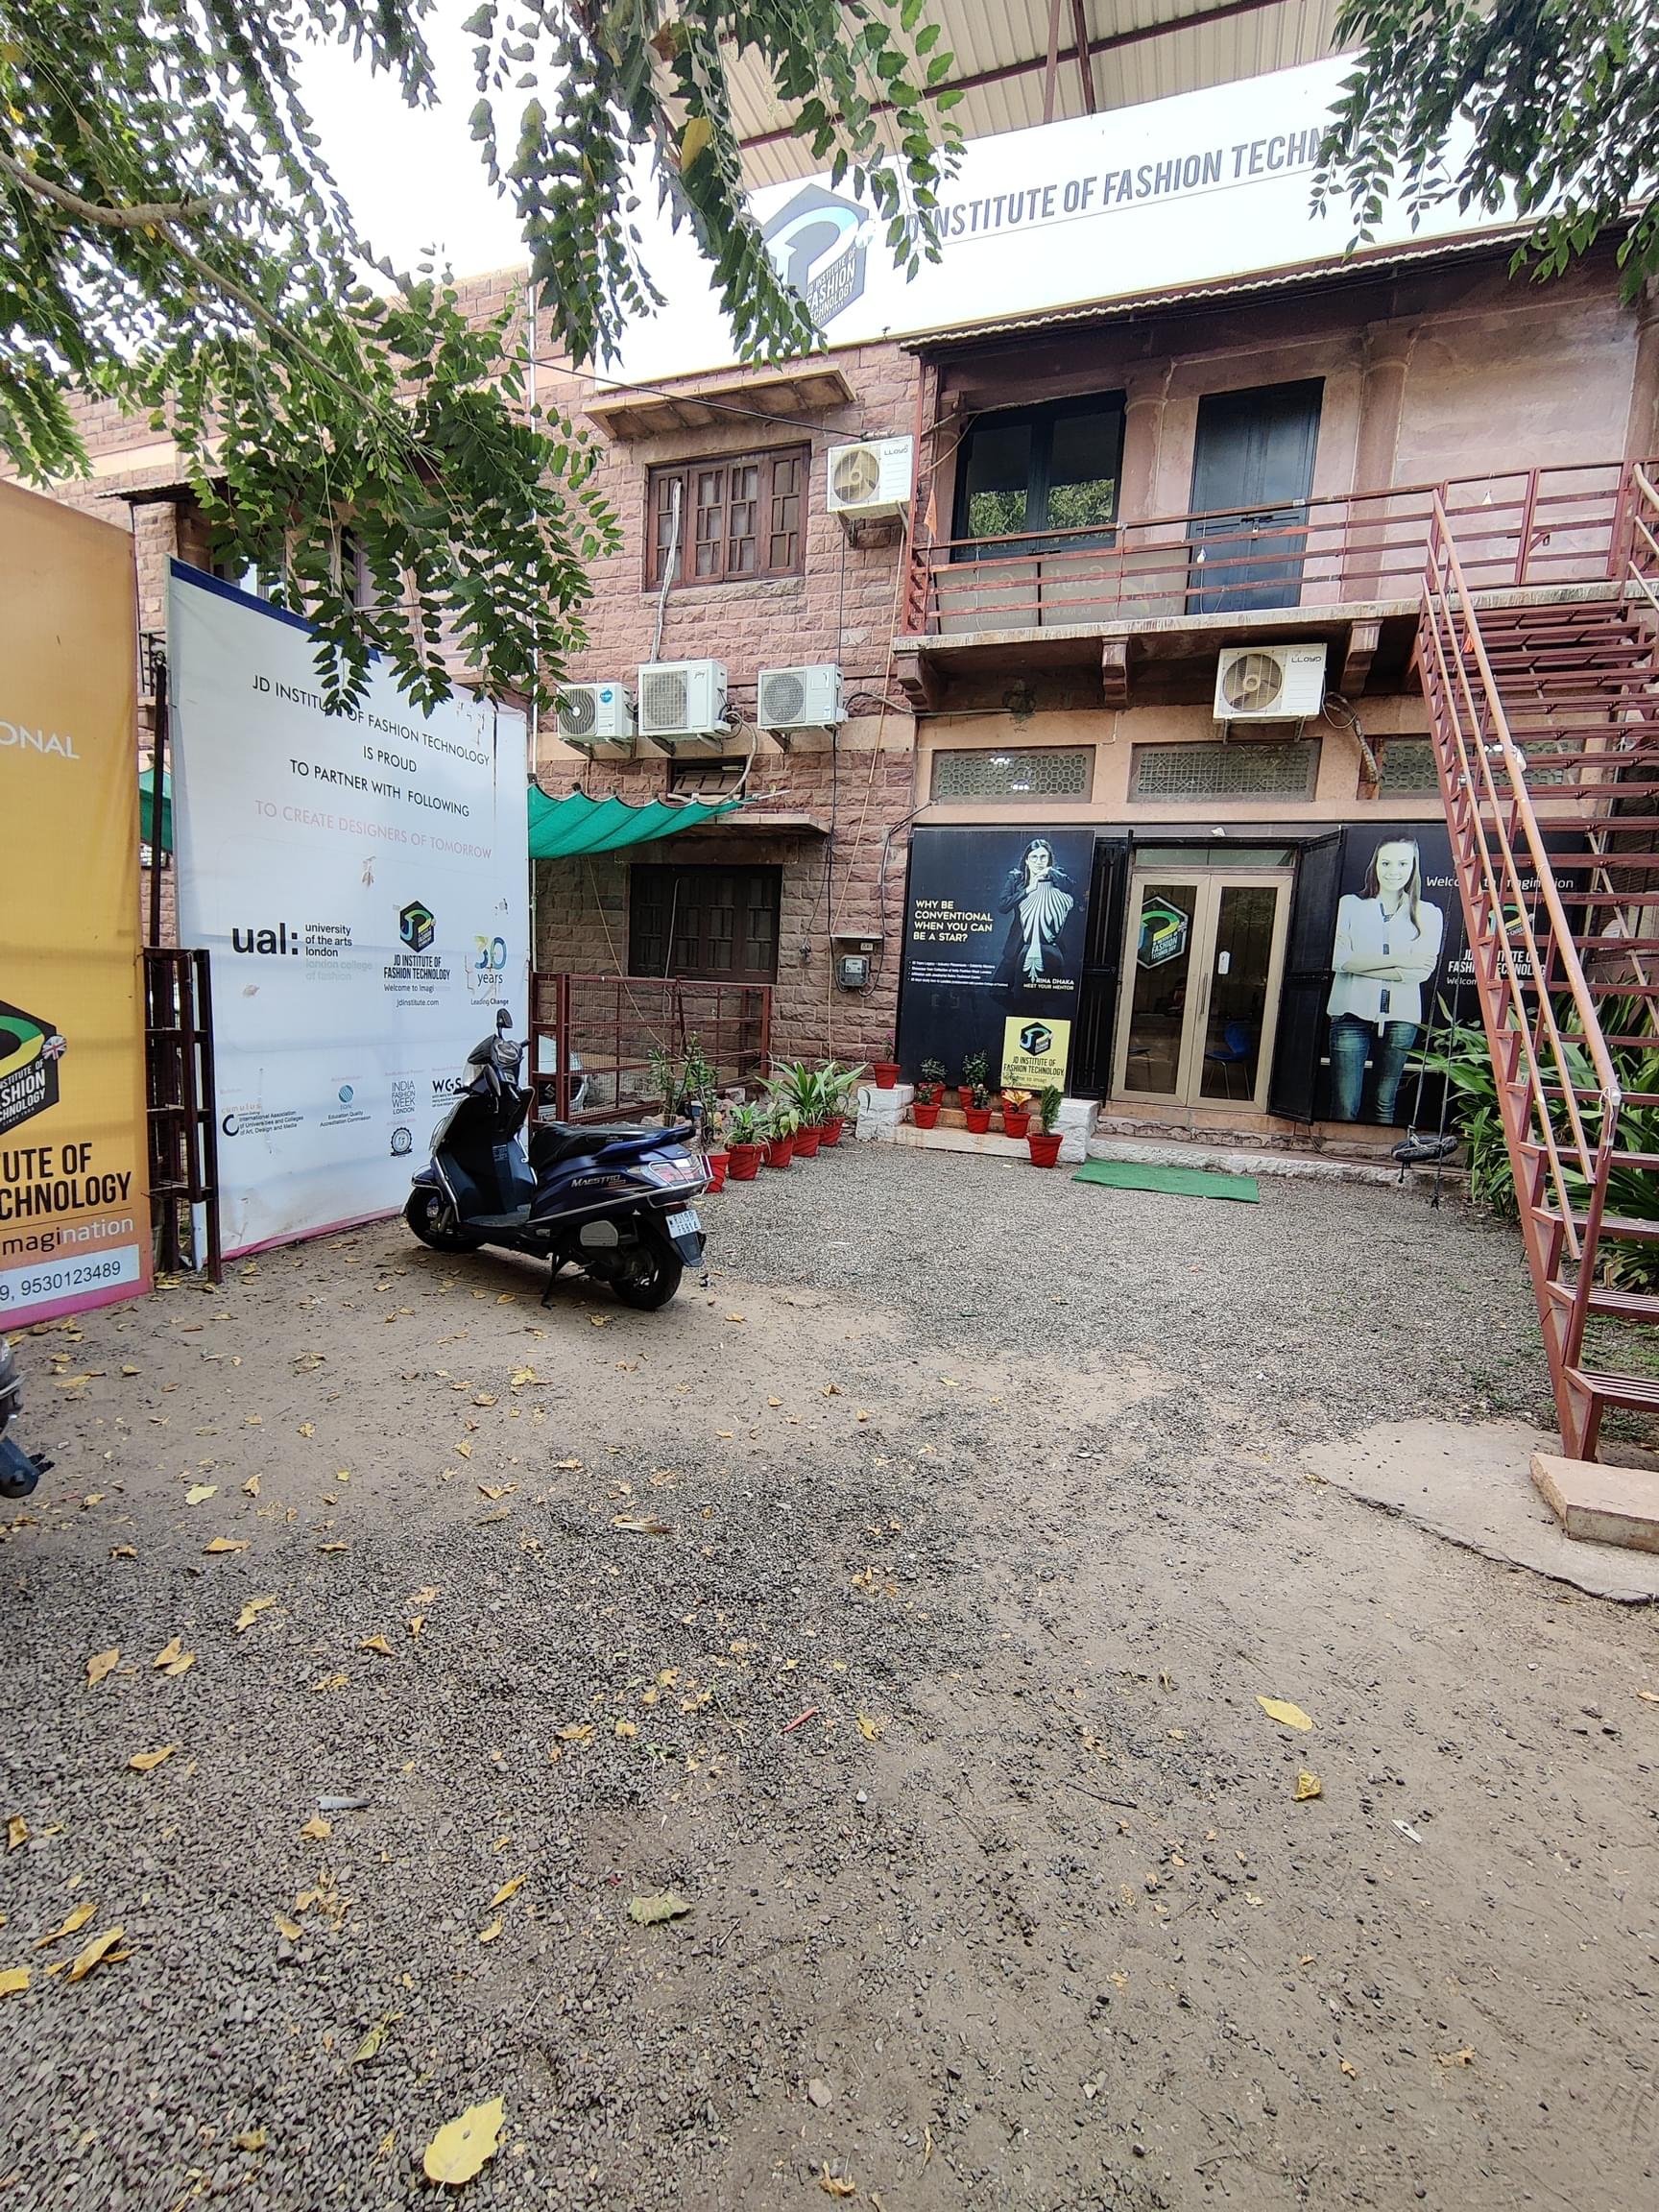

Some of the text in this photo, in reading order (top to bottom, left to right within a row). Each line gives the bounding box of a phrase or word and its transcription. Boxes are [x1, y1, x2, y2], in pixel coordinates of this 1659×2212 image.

[1064, 177, 1097, 213] OF
[1102, 150, 1223, 205] FASHION
[806, 258, 855, 307] FASHION
[252, 675, 270, 692] JD
[369, 714, 420, 743] FASHION
[422, 733, 491, 766] TECHNOLOGY
[363, 746, 417, 773] IS PROUD
[290, 759, 469, 817] TO PARTNER WITH FOLLOWING
[254, 800, 492, 859] TO CREATE DESIGNERS OF TOMORROW
[1426, 876, 1462, 887] Welco
[915, 900, 954, 909] WHY BE
[914, 910, 995, 922] CONVENTIONAL
[914, 921, 993, 932] WHEN YOU CAN
[232, 923, 351, 955] ual: university
[305, 935, 352, 947] of the arts
[913, 931, 969, 942] BE A STAR?
[305, 946, 339, 957] london
[305, 959, 373, 973] london college
[394, 954, 442, 968] JD INSTITUTE OF
[384, 967, 451, 980] FASHION TECHNOLOGY
[477, 974, 504, 987] years
[384, 983, 411, 992] Welcome
[471, 998, 509, 1006] Leading Change
[35, 1059, 44, 1070] OF
[1020, 1056, 1048, 1066] INSTITUTE
[1003, 1063, 1065, 1075] FASHION TECHNOLOGY
[392, 1080, 415, 1092] INDIA
[392, 1090, 416, 1098] FASHION
[222, 1103, 262, 1114] cumulus
[392, 1097, 416, 1108] WEEK
[62, 1142, 93, 1175] OF
[570, 1174, 621, 1188] MAESTRO
[21, 1261, 122, 1296] 9530123489
